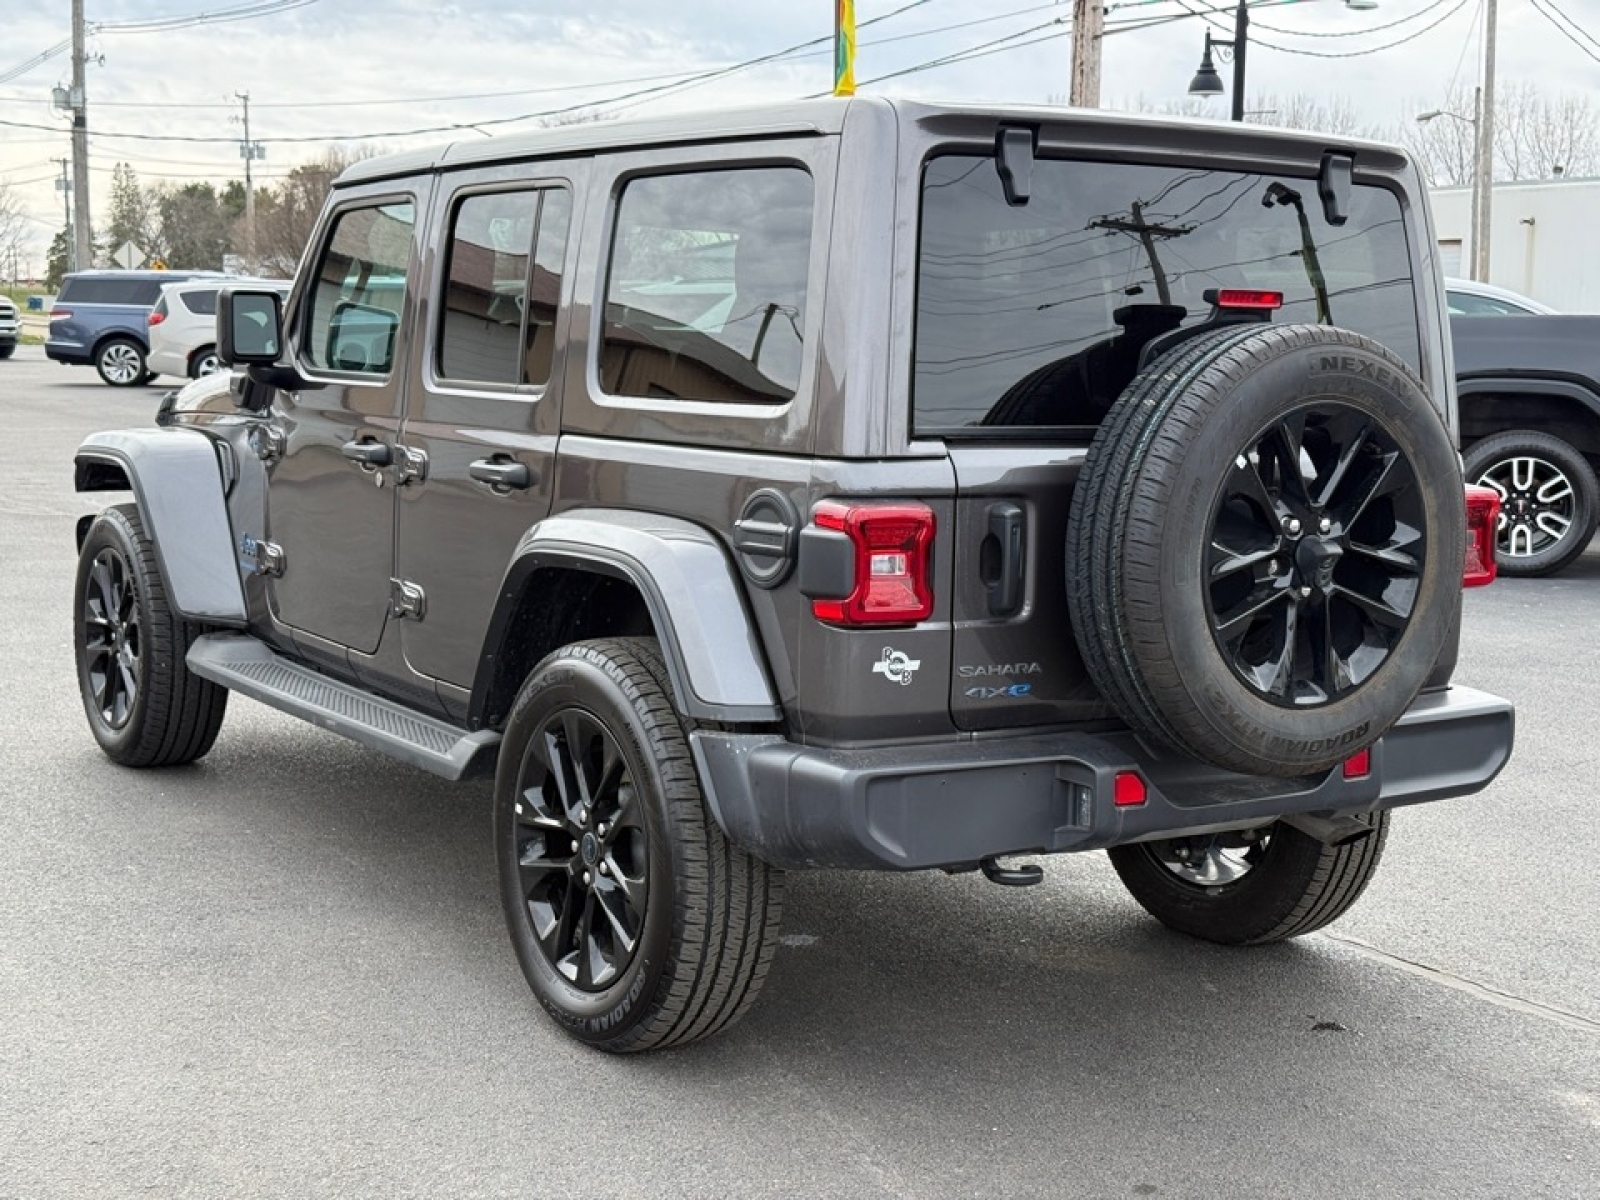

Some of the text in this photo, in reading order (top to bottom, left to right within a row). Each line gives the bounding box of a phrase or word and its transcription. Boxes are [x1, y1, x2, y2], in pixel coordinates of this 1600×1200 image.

[1320, 356, 1406, 399] NEXEN
[958, 662, 1042, 678] SAHARA
[1272, 720, 1371, 752] ROADIAN
